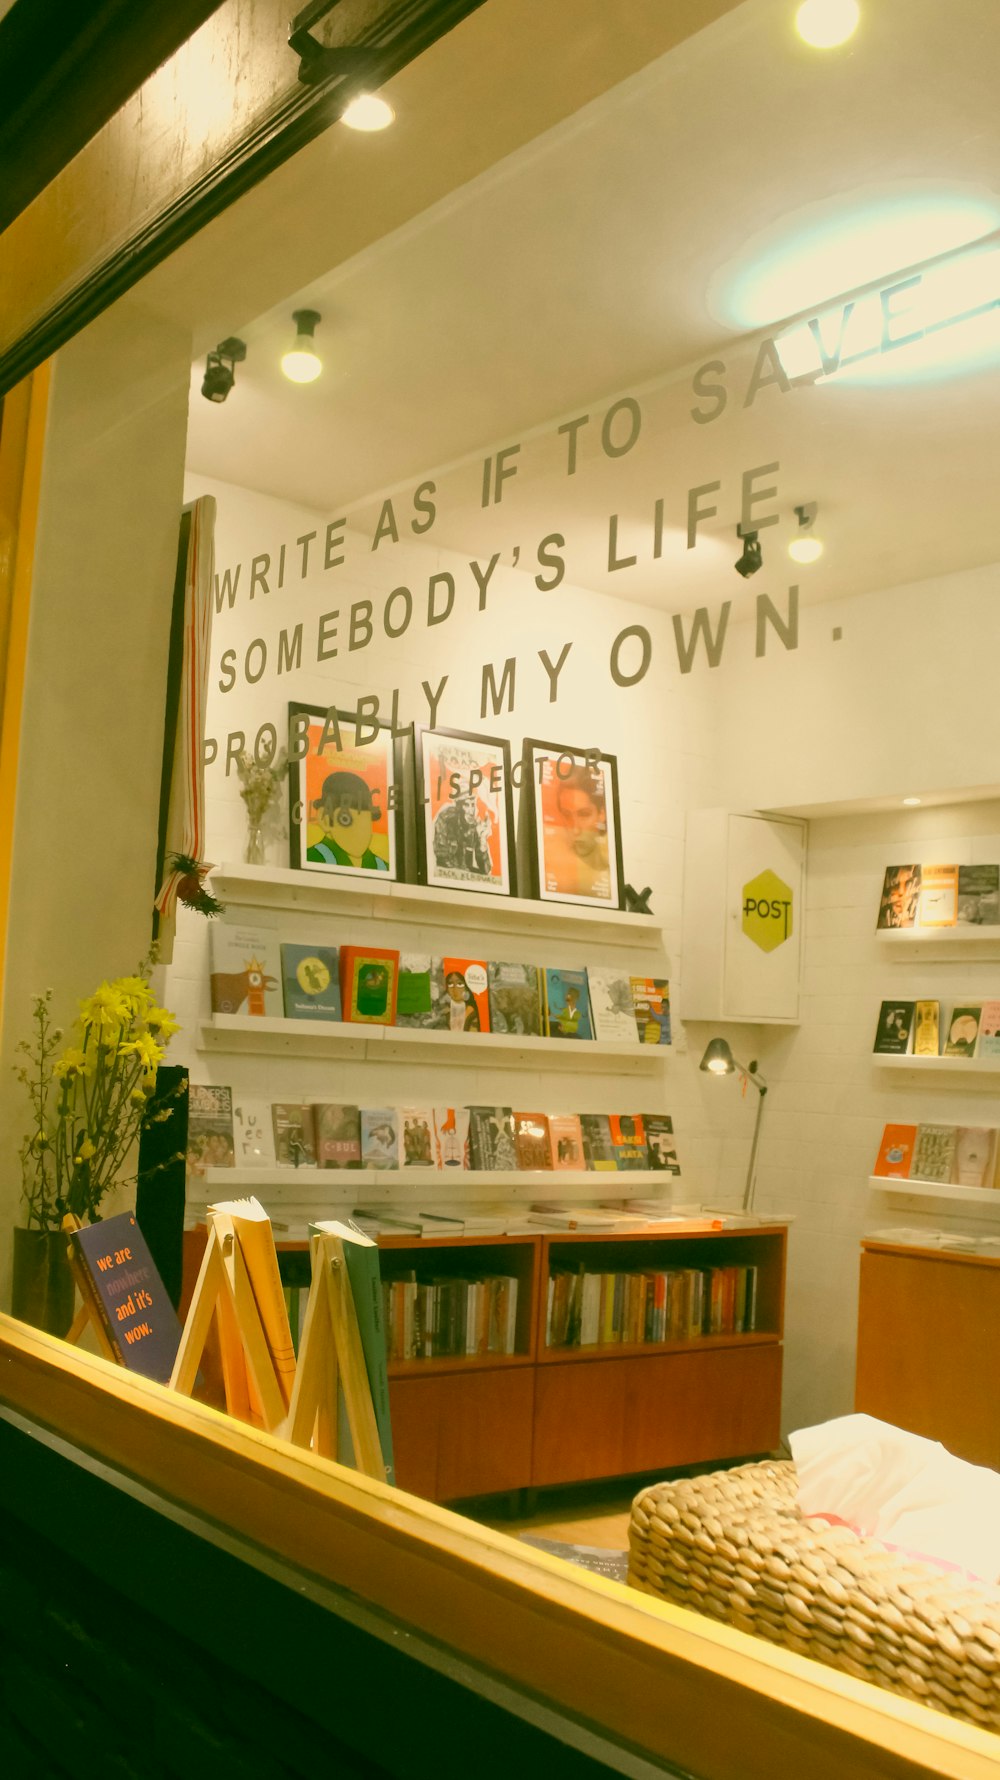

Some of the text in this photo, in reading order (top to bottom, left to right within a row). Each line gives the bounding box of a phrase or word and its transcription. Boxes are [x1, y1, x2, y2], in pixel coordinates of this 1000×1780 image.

[214, 274, 924, 614] WRITE AS IF TO SAVE
[218, 532, 566, 694] SOMEBODY'S
[201, 584, 843, 777] PROBABLY MY OWN.
[420, 747, 601, 804] LISPECTOR
[743, 898, 791, 941] POST
[96, 1247, 133, 1273] we are
[106, 1266, 149, 1297] nowhere
[115, 1289, 153, 1322] and it's
[124, 1322, 153, 1345] wow.
